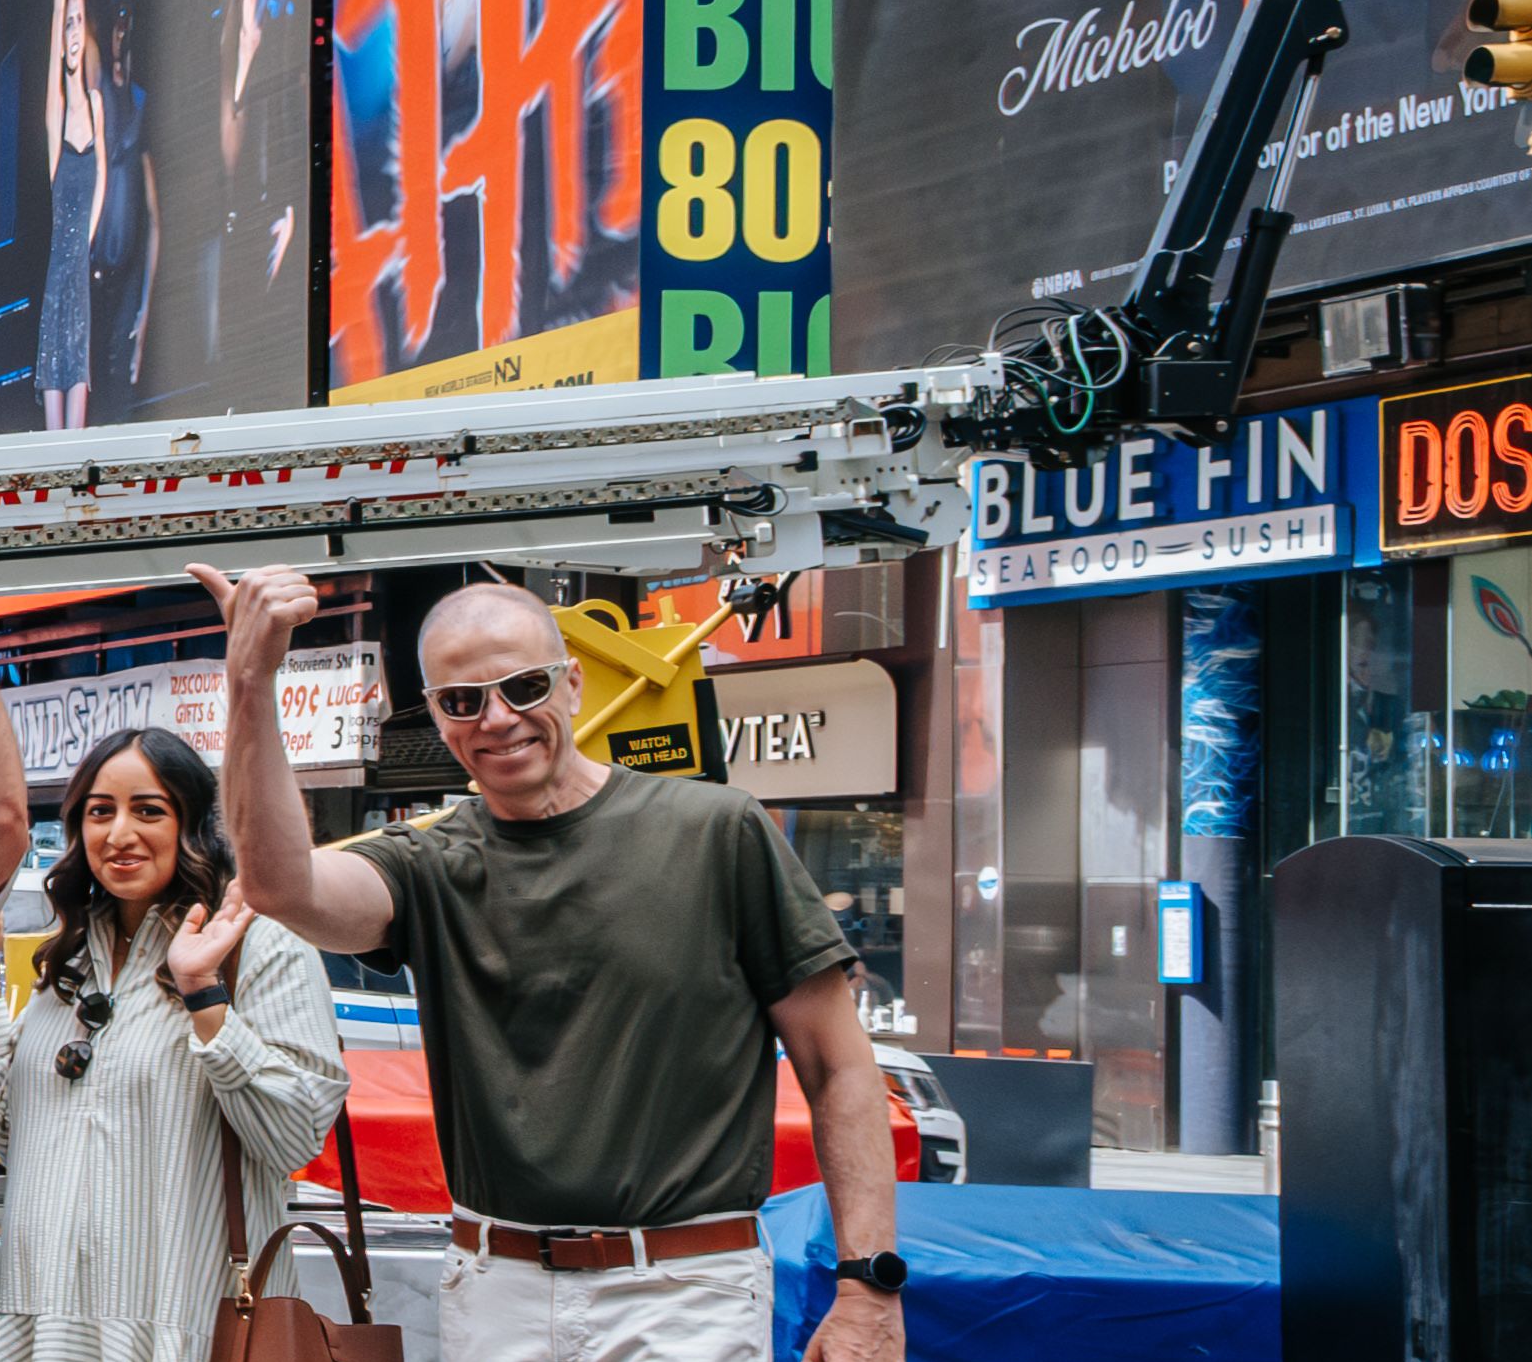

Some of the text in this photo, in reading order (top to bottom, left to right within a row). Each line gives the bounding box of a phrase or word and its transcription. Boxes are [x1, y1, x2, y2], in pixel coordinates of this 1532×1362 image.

[1325, 113, 1352, 153] of
[1354, 106, 1395, 145] the
[1399, 91, 1453, 135] New
[976, 409, 1327, 540] BLUE FIN
[977, 513, 1329, 587] SEAFOOD SUSHI
[174, 701, 204, 725] GIFTS
[617, 747, 688, 768] YOUR HEAD
[628, 734, 672, 751] WATCH
